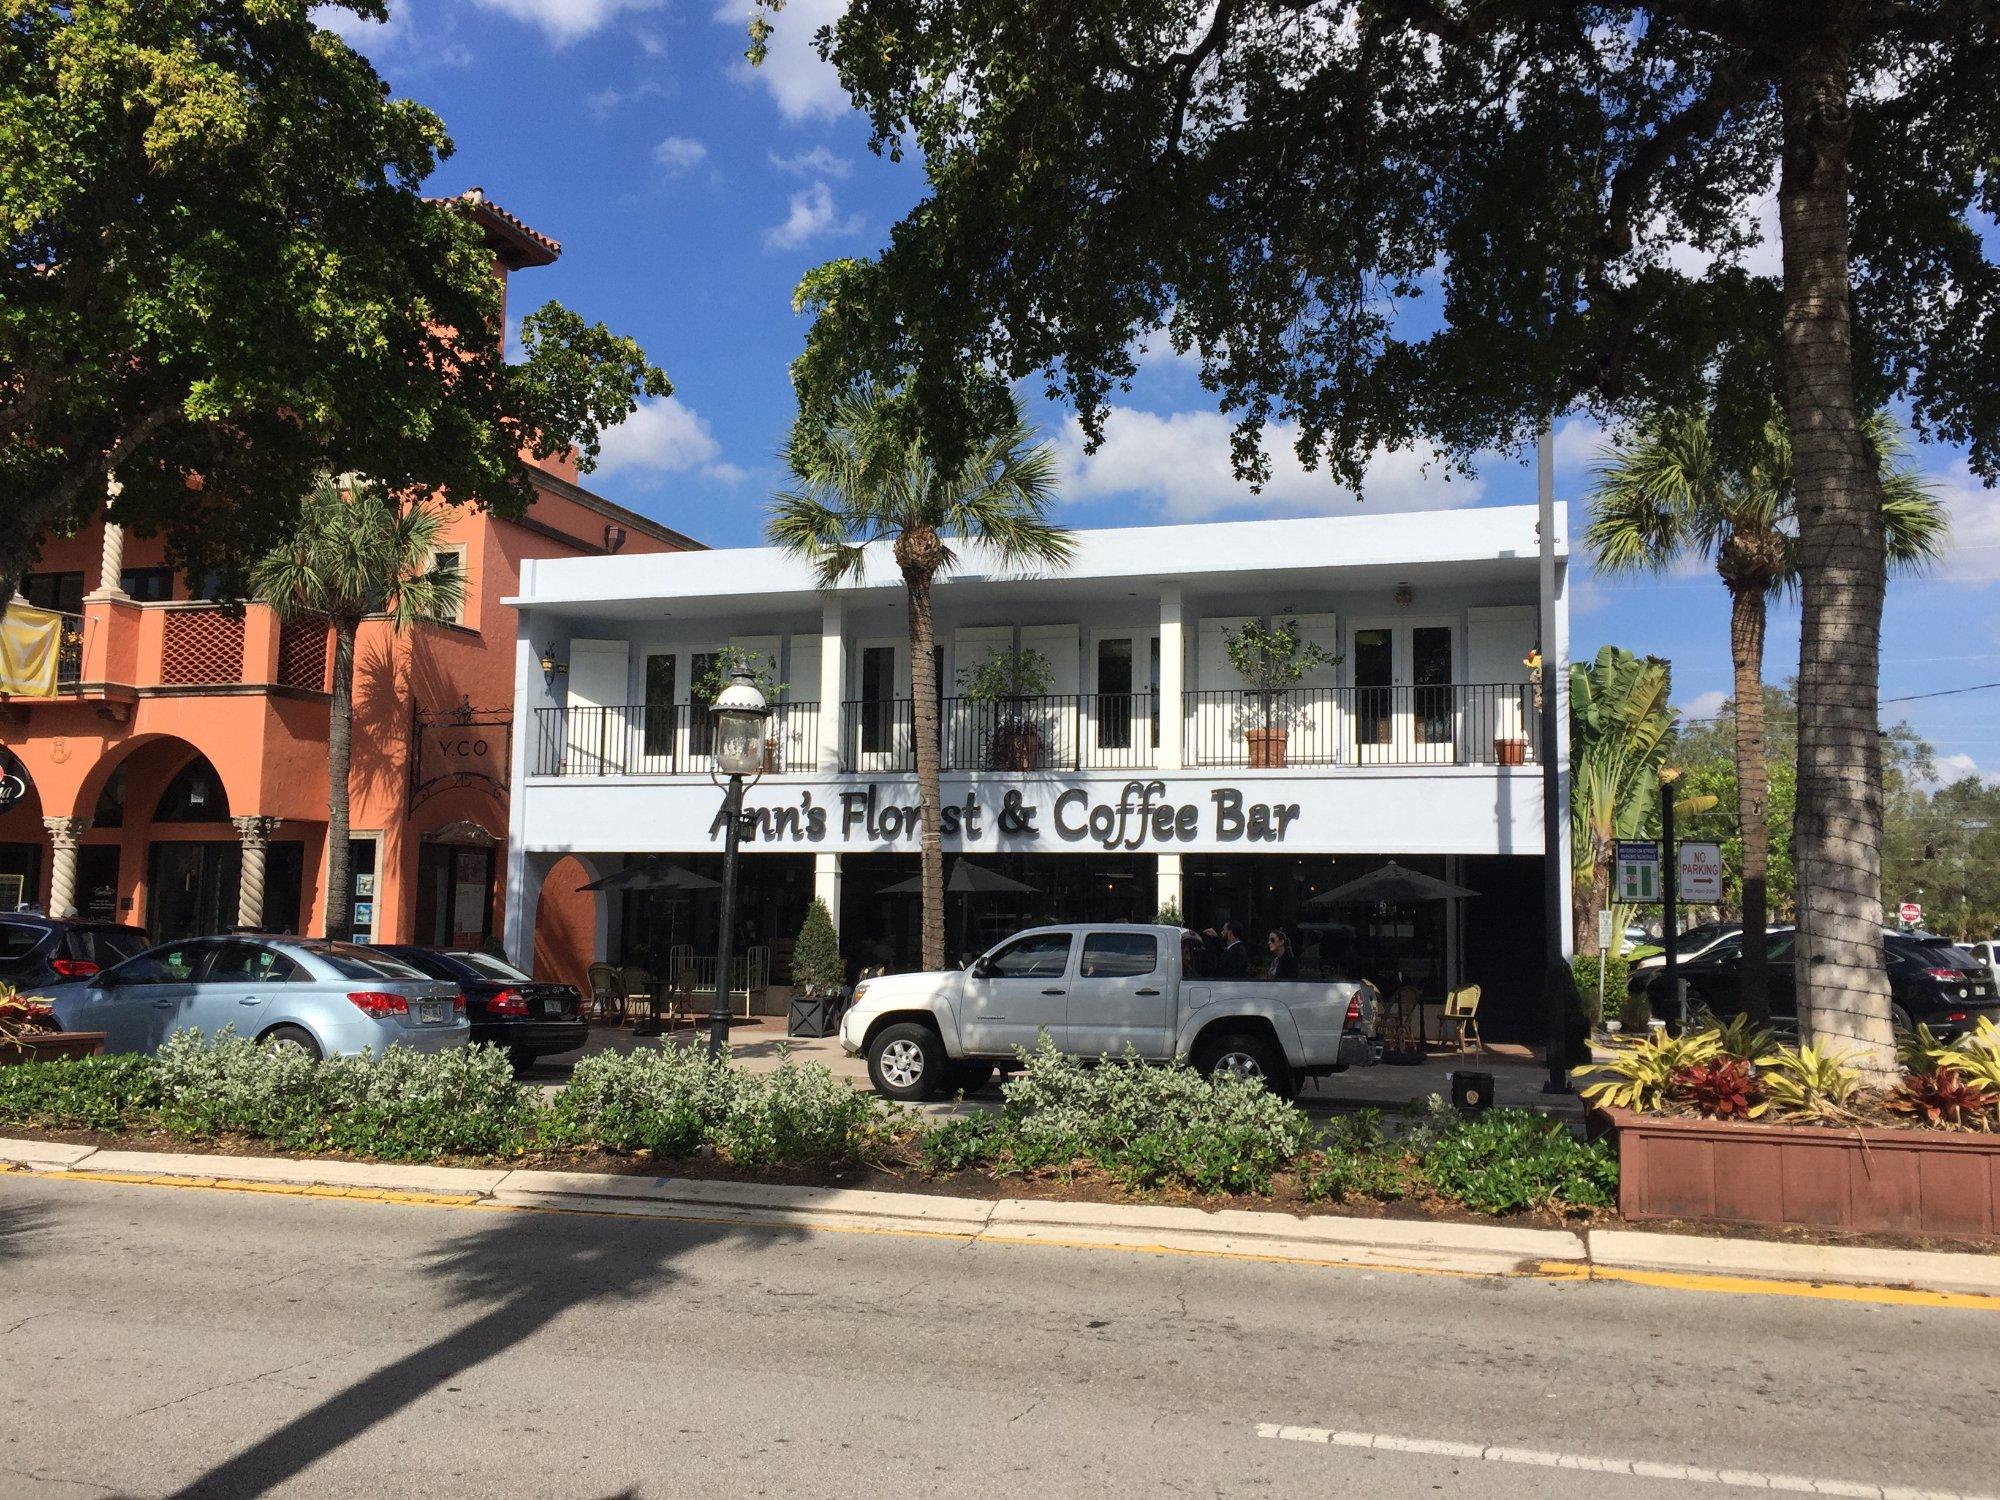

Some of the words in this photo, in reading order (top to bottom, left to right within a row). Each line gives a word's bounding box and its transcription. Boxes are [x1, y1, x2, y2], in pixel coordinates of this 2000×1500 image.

[839, 784, 983, 842] Florst
[997, 789, 1039, 840] &
[1054, 780, 1199, 851] Coffee
[1211, 787, 1300, 843] Bar
[1694, 851, 1706, 863] NO
[1682, 864, 1718, 875] PARKING
